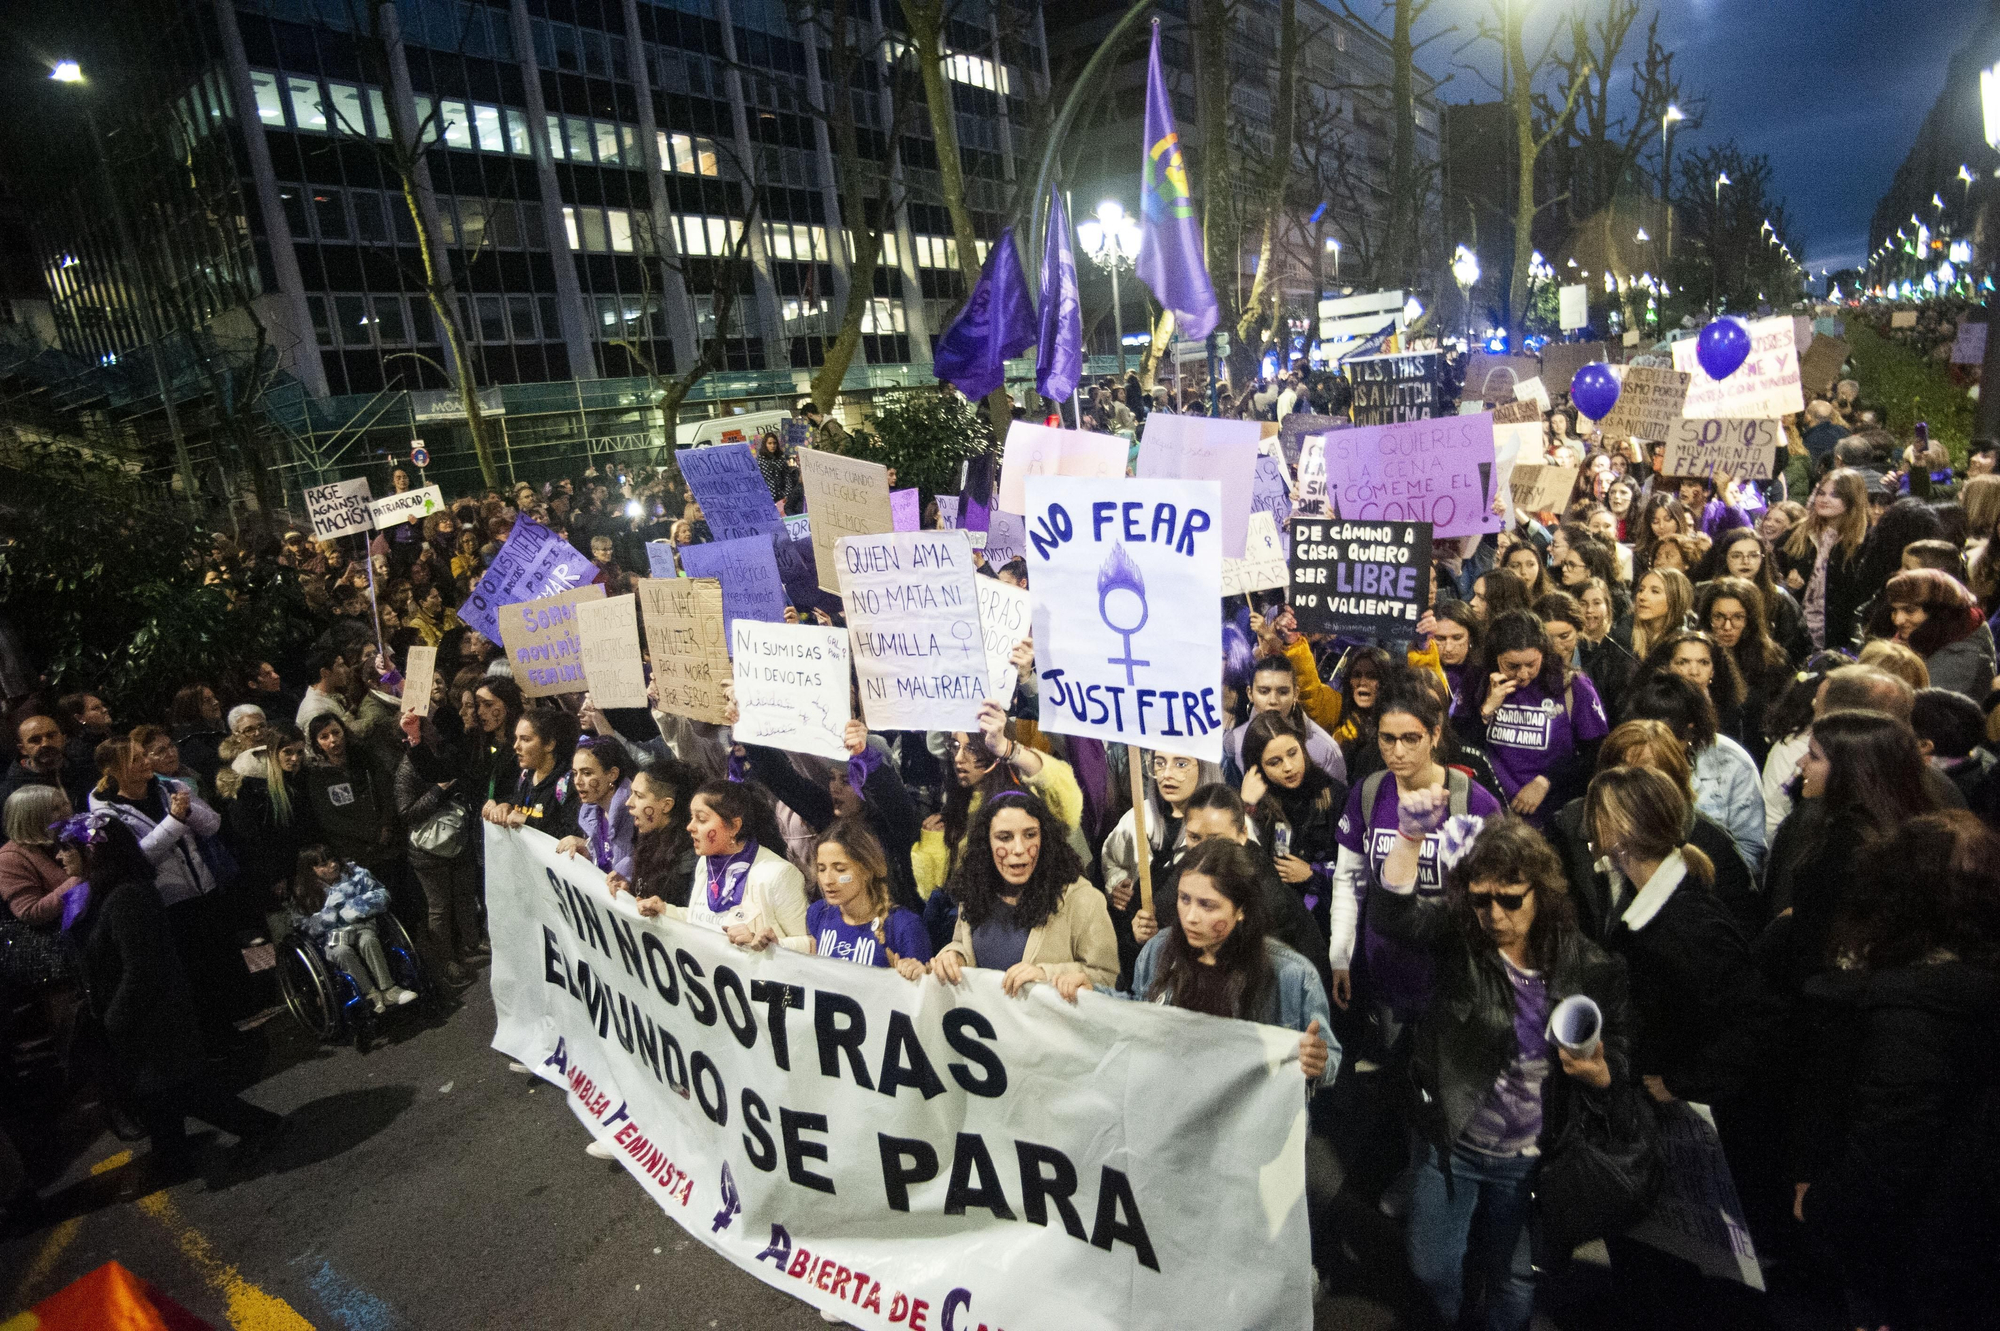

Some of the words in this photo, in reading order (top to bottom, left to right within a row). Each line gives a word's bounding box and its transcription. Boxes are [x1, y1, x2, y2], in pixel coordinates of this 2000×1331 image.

[1390, 357, 1425, 380] THIS
[1370, 384, 1380, 404] A
[1383, 382, 1432, 404] WITCH
[1378, 424, 1472, 456] QUIERES
[1678, 419, 1776, 447] SOMOS
[1675, 444, 1762, 460] MOVIMIENTO
[1384, 456, 1444, 479] CENA
[1674, 458, 1770, 481] FEMINISTA
[307, 485, 343, 506] RAGE
[1451, 475, 1472, 489] EL
[313, 495, 360, 518] AGAINST
[1359, 495, 1456, 527] COÑO
[1029, 502, 1073, 562] NO
[1092, 501, 1211, 557] FEAR
[1295, 525, 1322, 541] DE
[1329, 523, 1392, 544] CAMINO
[1403, 527, 1414, 544] A
[845, 545, 901, 574] QUIEN
[913, 543, 955, 570] AMA
[1296, 543, 1339, 560] CASA
[1348, 543, 1409, 563] QUIERO
[1295, 567, 1328, 584] SER
[1336, 561, 1418, 599] LIBRE
[649, 588, 666, 616] NO
[852, 589, 880, 615] NO
[886, 584, 938, 611] MATA
[941, 584, 962, 608] NI
[1295, 594, 1317, 608] NO
[1326, 596, 1418, 621] VALIENTE
[660, 627, 701, 656] MUJER
[738, 629, 758, 654] NI
[762, 641, 822, 660] SUMISAS
[855, 631, 941, 658] HUMILLA
[658, 658, 677, 676] PARA
[684, 661, 713, 682] MORIR
[738, 661, 758, 680] NI
[764, 667, 822, 687] DEVOTAS
[664, 687, 679, 708] POR
[683, 684, 710, 709] SERLO
[866, 677, 887, 700] NI
[896, 675, 986, 700] MALTRATA
[1041, 668, 1125, 733] JUST
[1136, 687, 1222, 737] FIRE
[1491, 726, 1516, 743] COMO
[1516, 730, 1543, 746] ARMA
[817, 928, 838, 958] NO
[852, 936, 876, 966] NO
[546, 866, 612, 960] SIN
[606, 908, 1008, 1101] NOSOTRAS
[542, 923, 584, 1003] EL
[577, 959, 728, 1127] MUNDO
[741, 1087, 836, 1196] SE
[877, 1131, 1161, 1274] PARA
[755, 1222, 882, 1315] ABIERTA
[887, 1290, 930, 1331] DE
